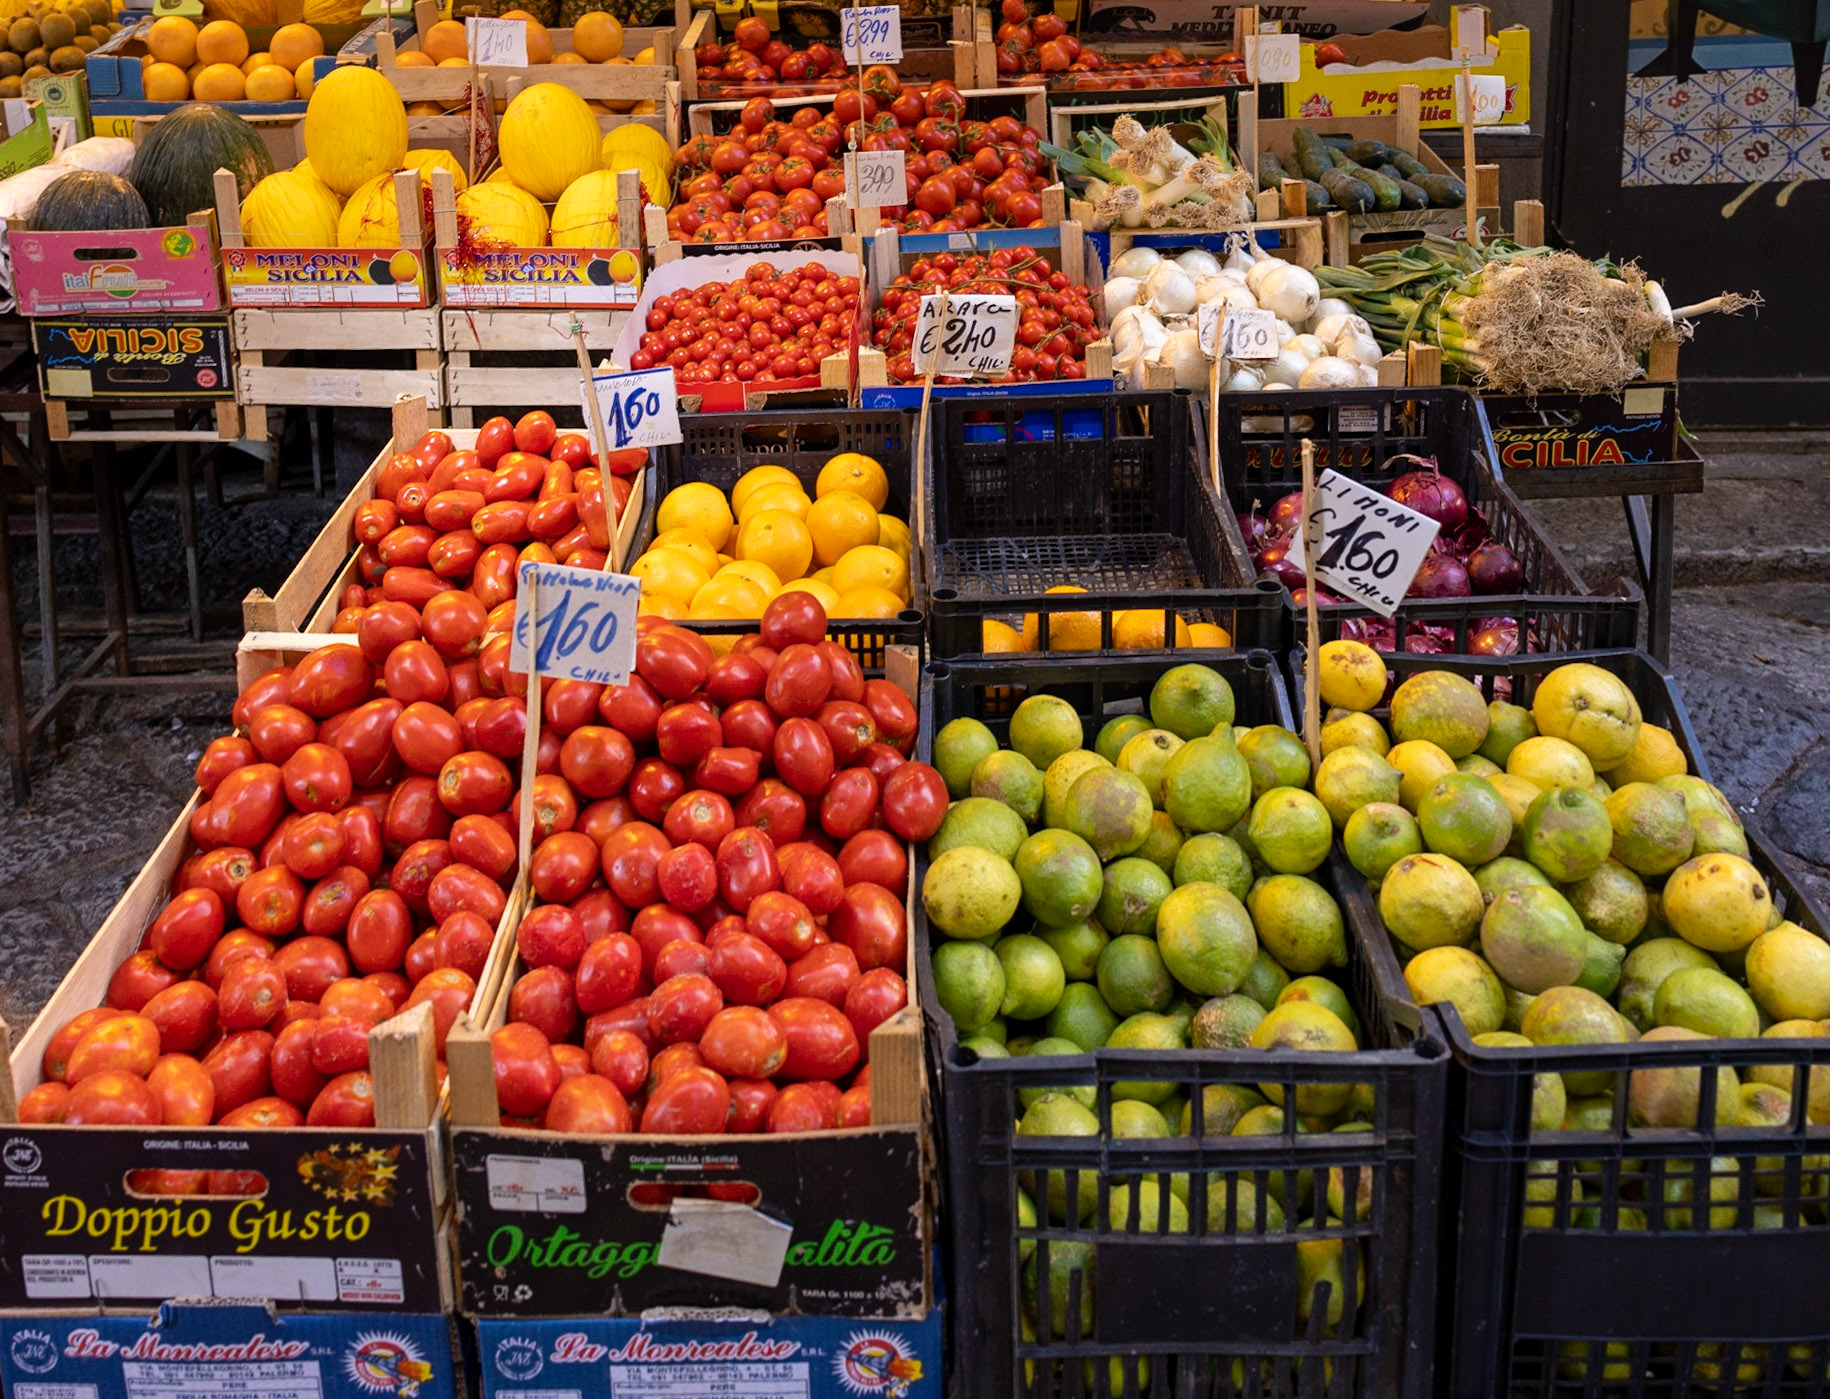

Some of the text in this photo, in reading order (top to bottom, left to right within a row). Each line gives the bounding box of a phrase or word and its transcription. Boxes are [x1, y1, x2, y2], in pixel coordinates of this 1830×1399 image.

[1211, 5, 1306, 20] TNIT
[255, 253, 361, 269] MELONI
[474, 253, 579, 268] MELONI
[267, 269, 364, 283] SICILIA
[484, 268, 582, 283] SICILIA
[68, 328, 204, 353] SICILIA
[113, 352, 187, 365] Bontà
[1491, 427, 1578, 442] Bontà
[1320, 476, 1420, 533] LIMONI
[143, 1140, 183, 1149] ORIGINE:
[184, 1141, 212, 1149] ITALIA
[218, 1141, 249, 1150] SICILIA
[667, 1154, 700, 1163] ITALIA
[42, 1194, 371, 1253] Doppio Gusto
[801, 1289, 826, 1298] TARA
[13, 1329, 51, 1344] ITALIA
[498, 1336, 537, 1352] ITALIA
[64, 1328, 120, 1359] La
[121, 1332, 311, 1361] Monrealese
[549, 1332, 609, 1364] La
[609, 1332, 802, 1363] Monrealese
[748, 1371, 794, 1379] PALERMO
